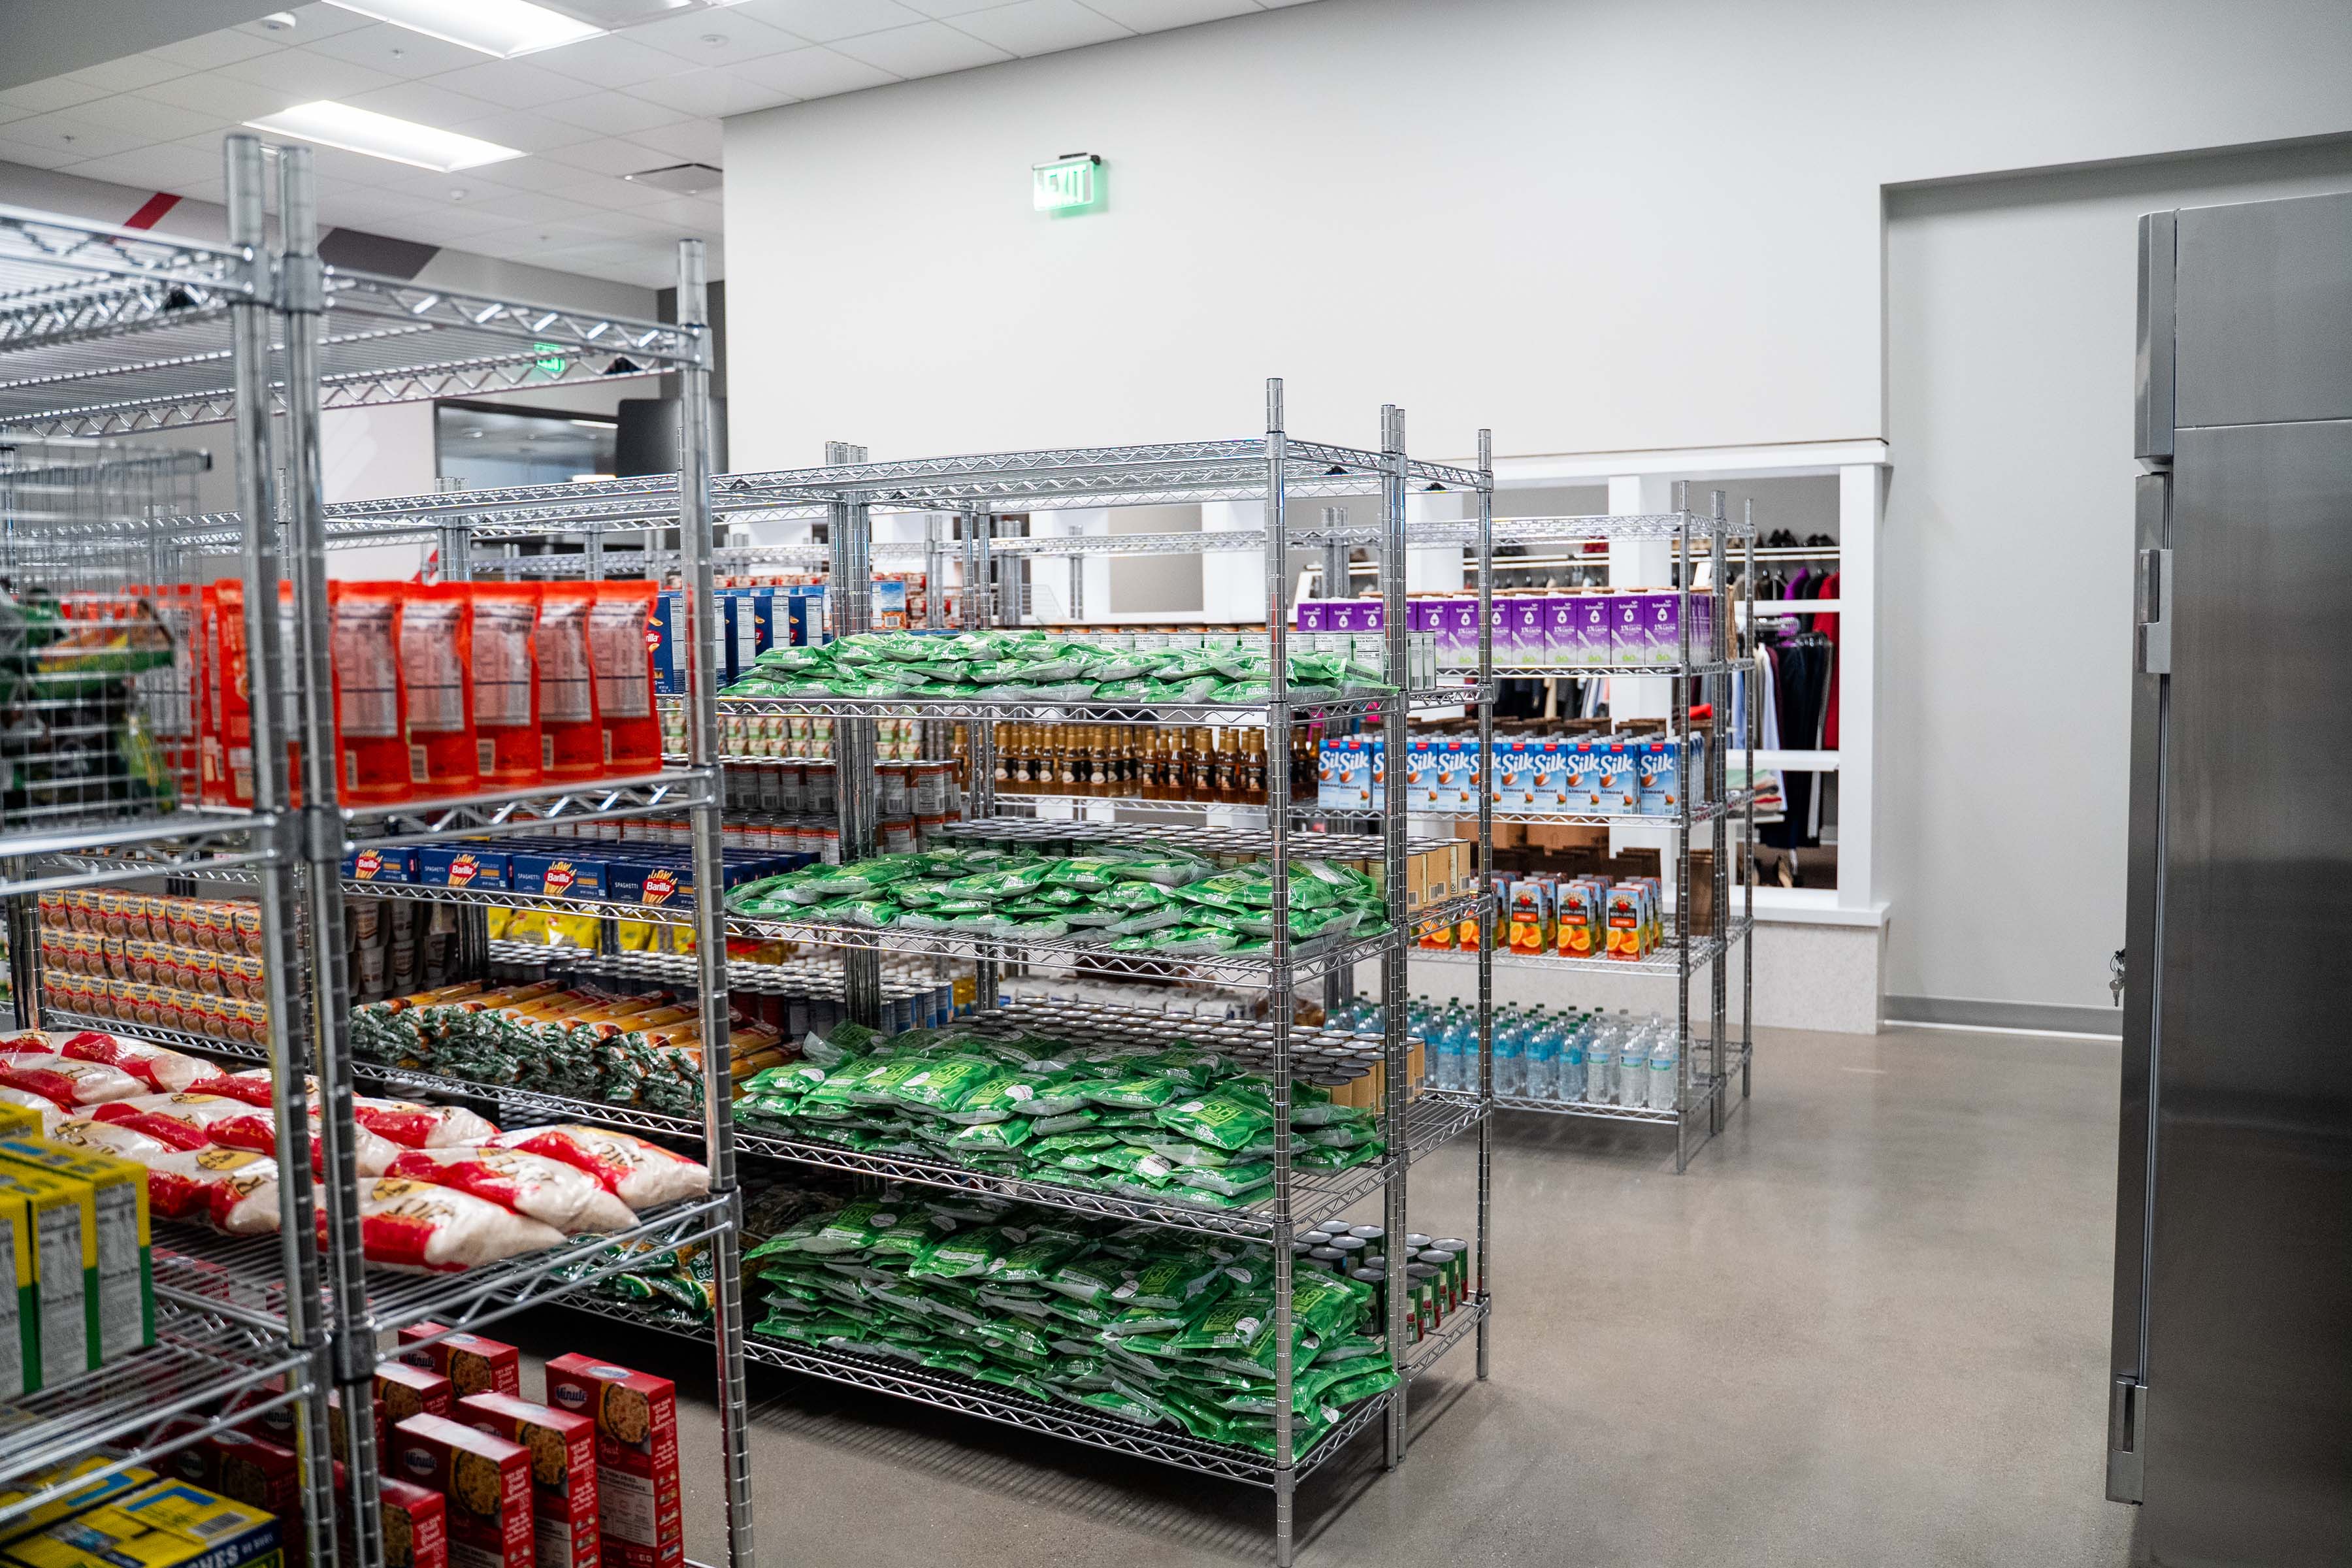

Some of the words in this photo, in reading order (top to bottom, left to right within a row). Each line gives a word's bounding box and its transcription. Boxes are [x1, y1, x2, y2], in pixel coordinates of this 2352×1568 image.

[1043, 164, 1087, 207] EXIT
[1318, 751, 1339, 772] Sil
[1339, 751, 1369, 772] Silk
[1407, 753, 1437, 774] Silk
[1437, 753, 1469, 775] Silk
[1501, 753, 1534, 776] Silk
[1533, 753, 1567, 776] Silk
[1566, 753, 1600, 776] Silk
[1599, 754, 1633, 776] Silk
[1640, 754, 1674, 777] Silk
[358, 859, 378, 868] Barilla
[451, 865, 474, 875] Barilla
[547, 873, 570, 883] Barilla
[614, 881, 639, 890] SPAGHETTI
[646, 881, 671, 892] Barilla
[555, 1386, 587, 1403] Minute
